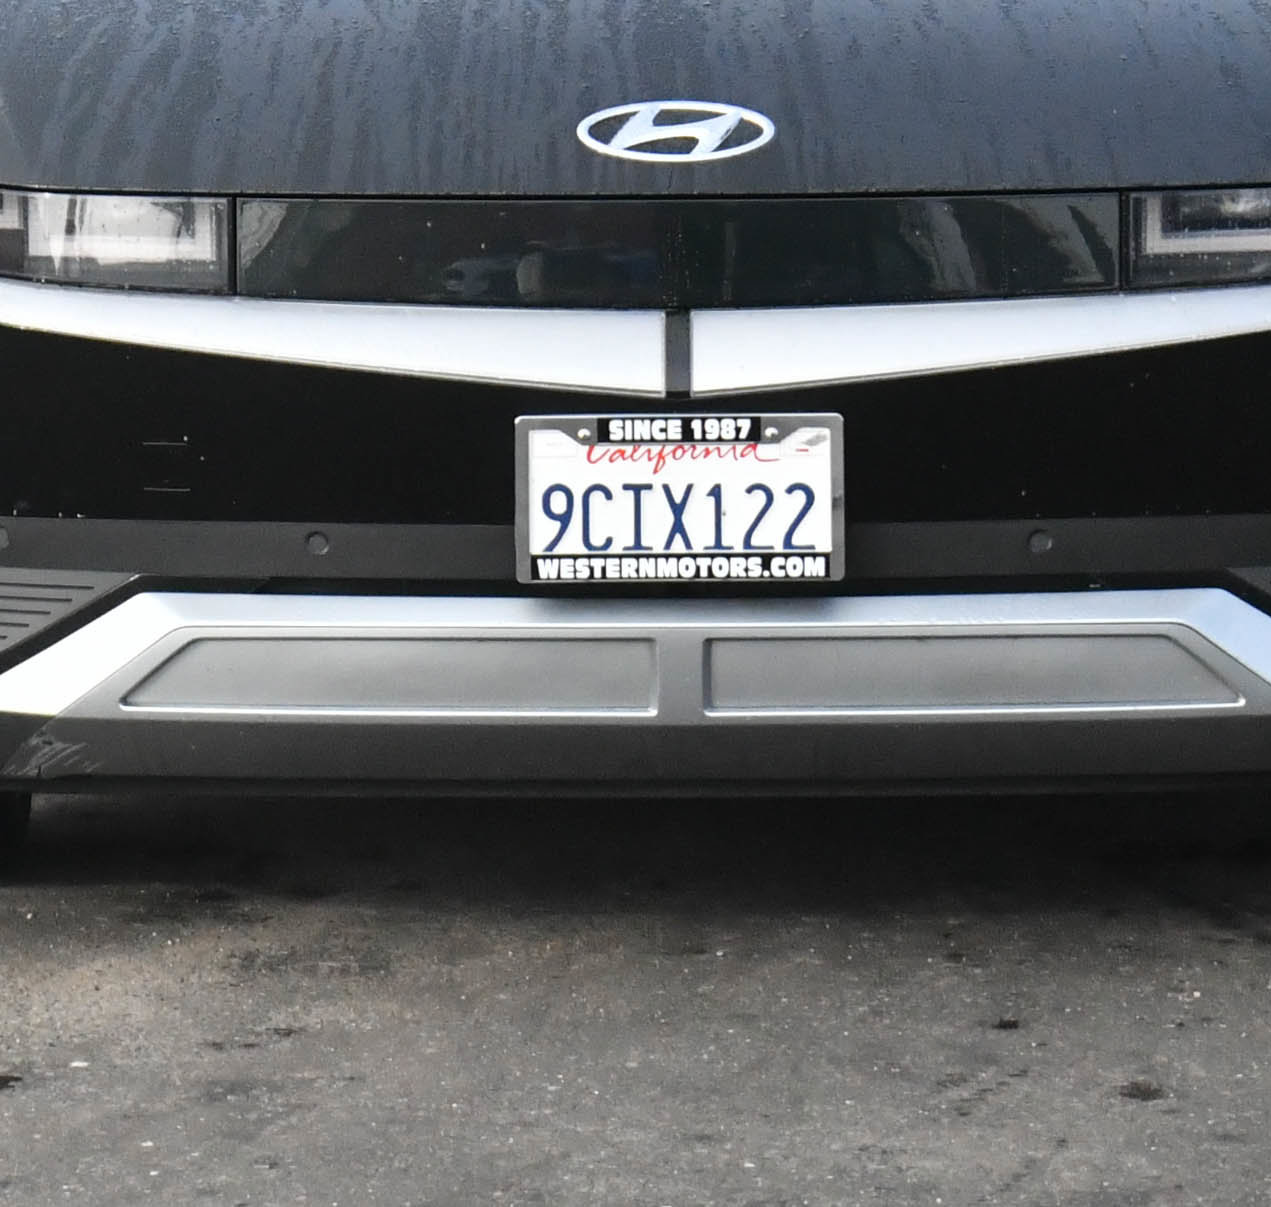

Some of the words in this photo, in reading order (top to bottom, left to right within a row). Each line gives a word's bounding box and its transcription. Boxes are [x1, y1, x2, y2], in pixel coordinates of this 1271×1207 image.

[608, 418, 682, 441] SINCE
[690, 418, 752, 441] 1987
[536, 556, 826, 579] WESTERNMOTORS.COM
